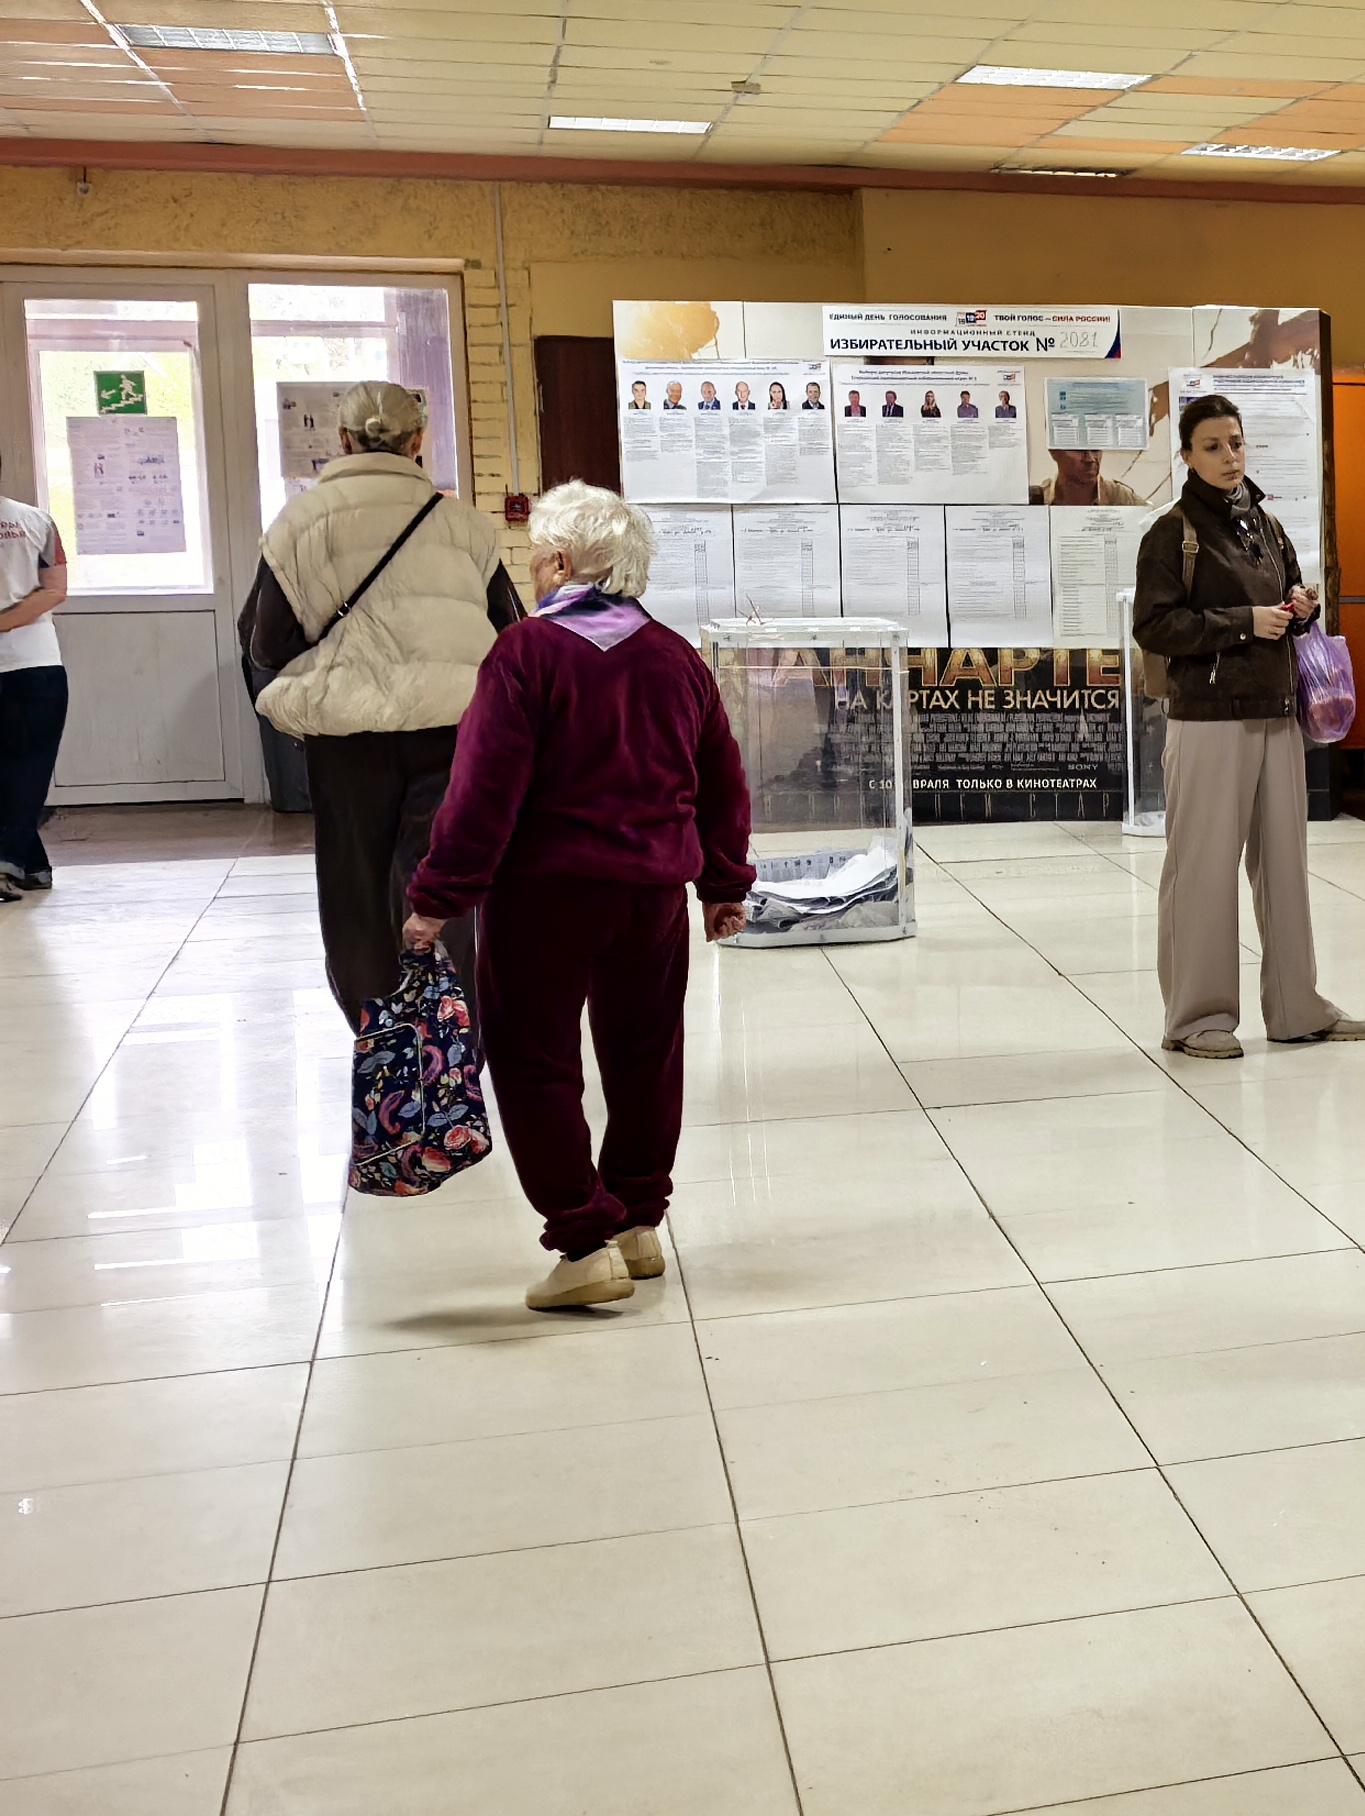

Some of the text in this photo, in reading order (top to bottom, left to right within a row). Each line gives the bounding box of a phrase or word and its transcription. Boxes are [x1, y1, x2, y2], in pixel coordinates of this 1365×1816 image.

[830, 337, 957, 351] ИЗБИРАТЕЛЬНЫЙ
[962, 339, 1029, 351] УЧАСТОК
[876, 689, 959, 710] КРТАХ
[968, 689, 996, 710] НЕ
[1003, 689, 1120, 710] ЗНАЧИТСЯ
[912, 779, 950, 789] ВРАЛЯ
[956, 778, 1002, 789] ТОЛЬКО
[1006, 779, 1013, 788] В
[1017, 778, 1098, 789] КИНОТЕАТРАХ
